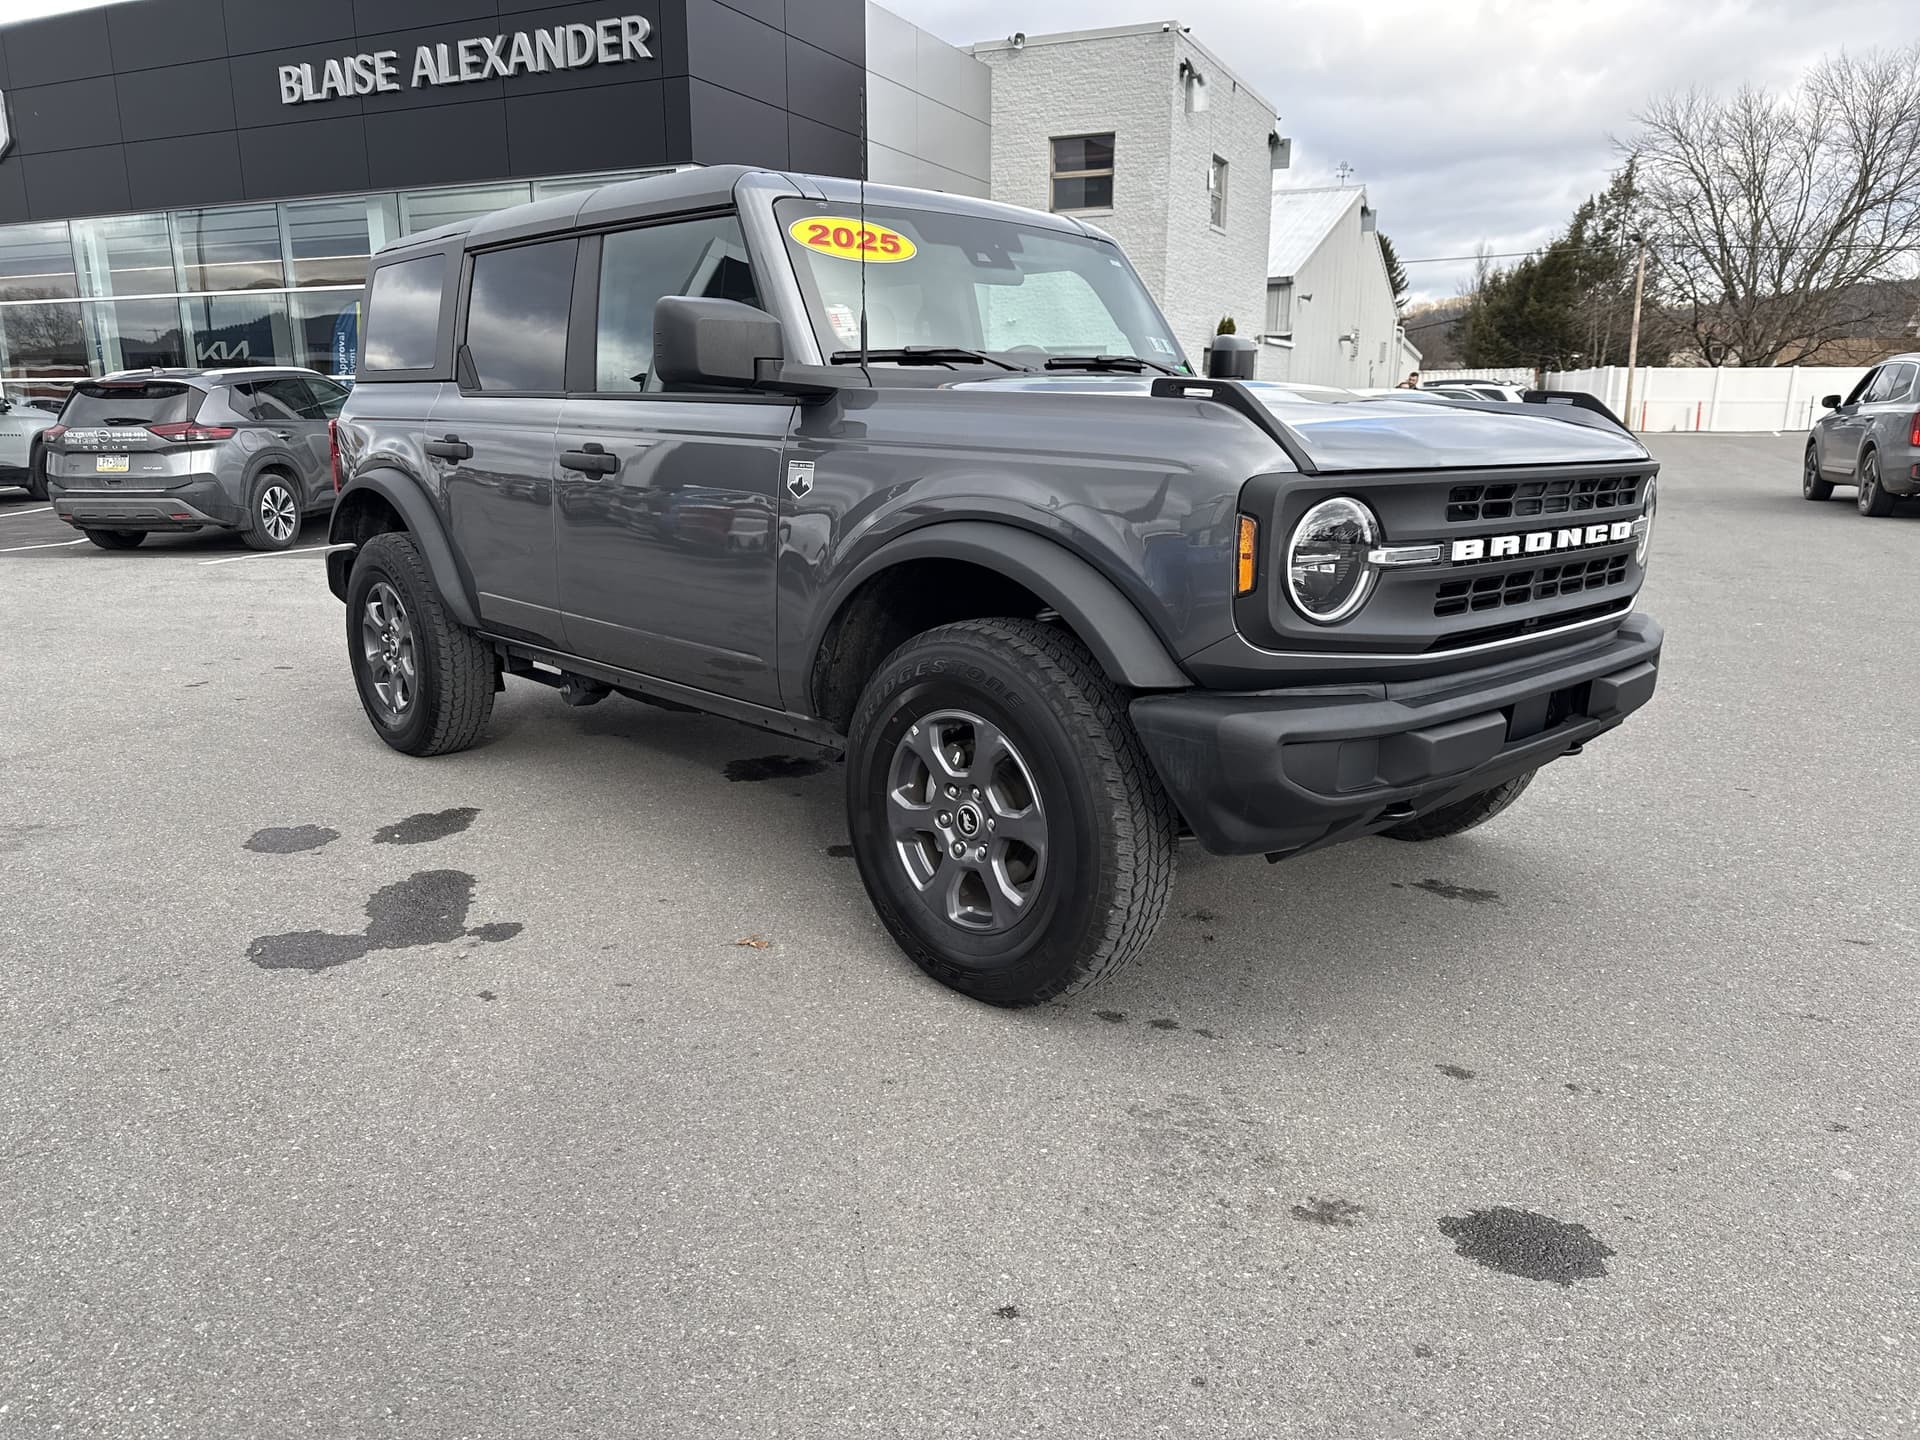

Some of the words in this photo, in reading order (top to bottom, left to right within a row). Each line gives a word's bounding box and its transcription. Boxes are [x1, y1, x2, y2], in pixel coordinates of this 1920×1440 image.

[278, 50, 401, 104] BLAISE
[411, 15, 654, 88] ALEXANDER
[808, 224, 901, 254] 2025
[337, 332, 348, 376] Approval
[348, 348, 356, 375] Event
[1451, 521, 1633, 562] BRONCO
[855, 656, 1027, 745] BRIDGESTONE
